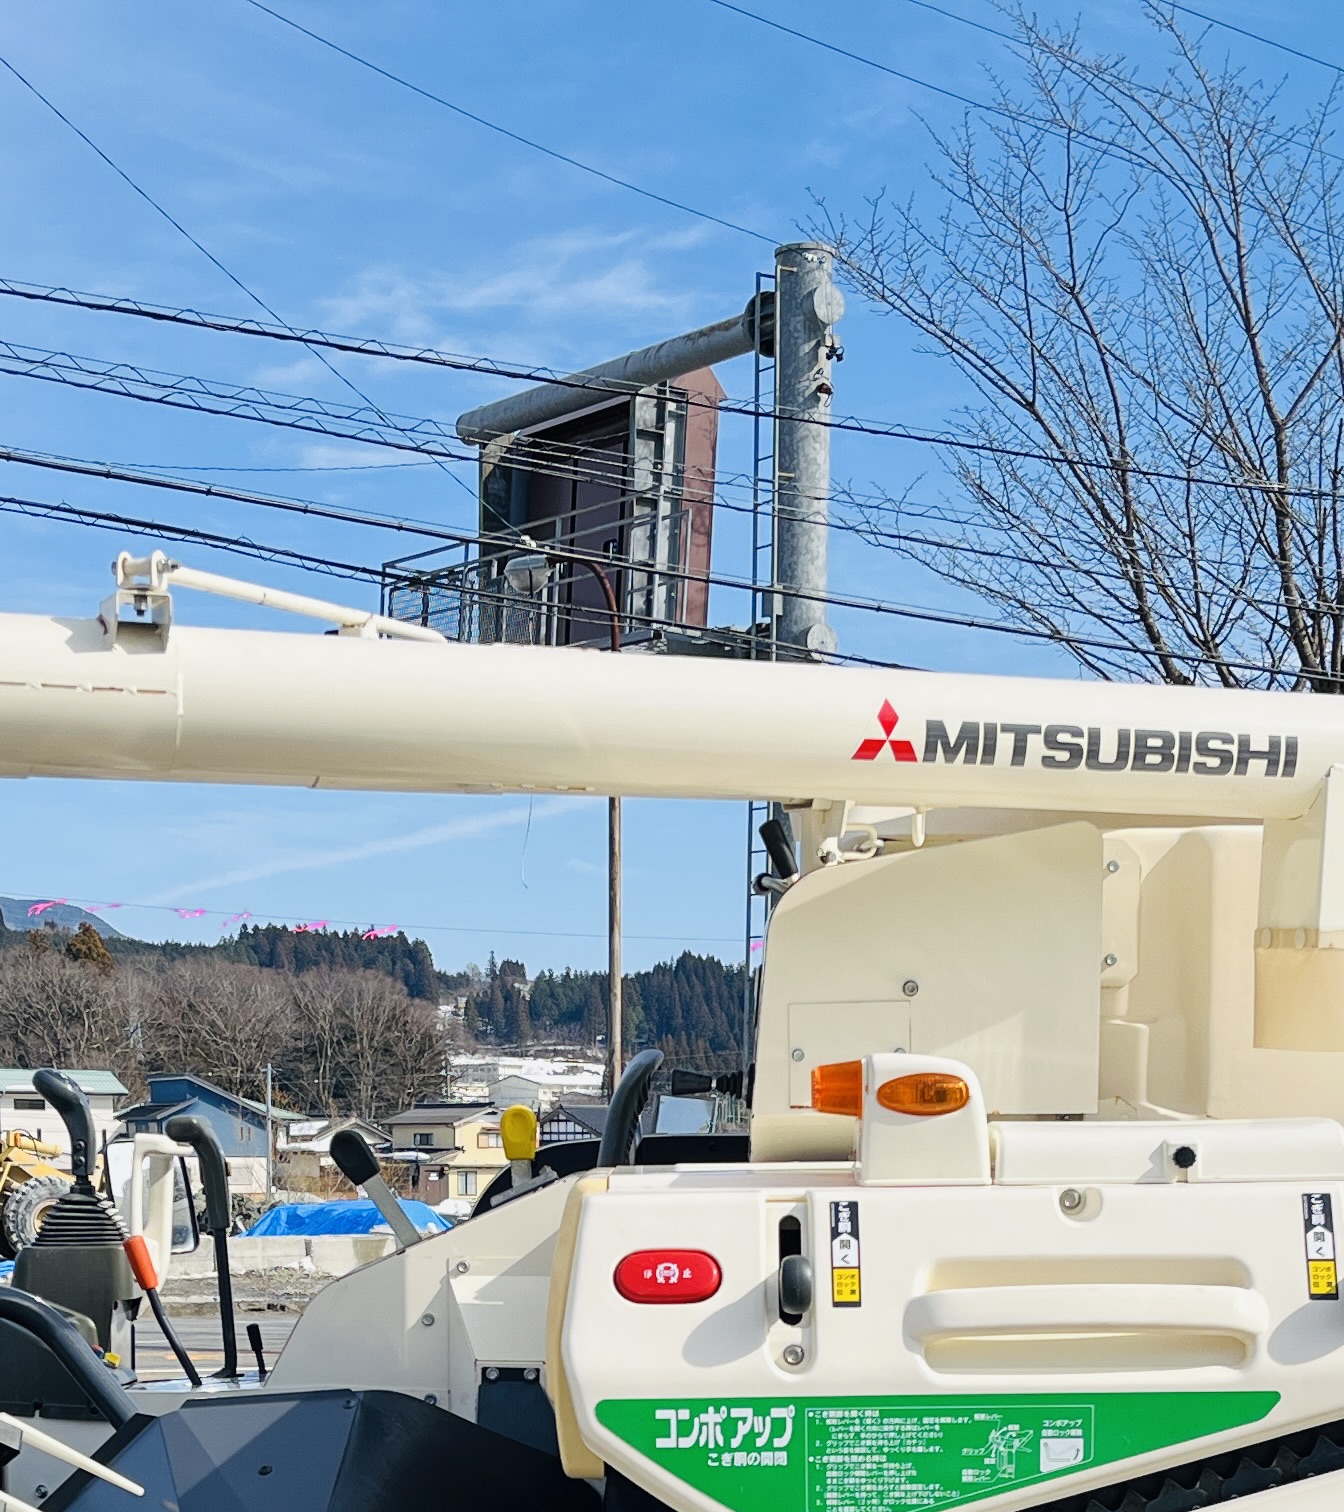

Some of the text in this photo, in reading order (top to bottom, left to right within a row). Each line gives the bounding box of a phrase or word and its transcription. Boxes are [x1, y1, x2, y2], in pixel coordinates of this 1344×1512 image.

[922, 718, 1299, 779] MITSUBISHI
[655, 1404, 795, 1449] コンポアップ
